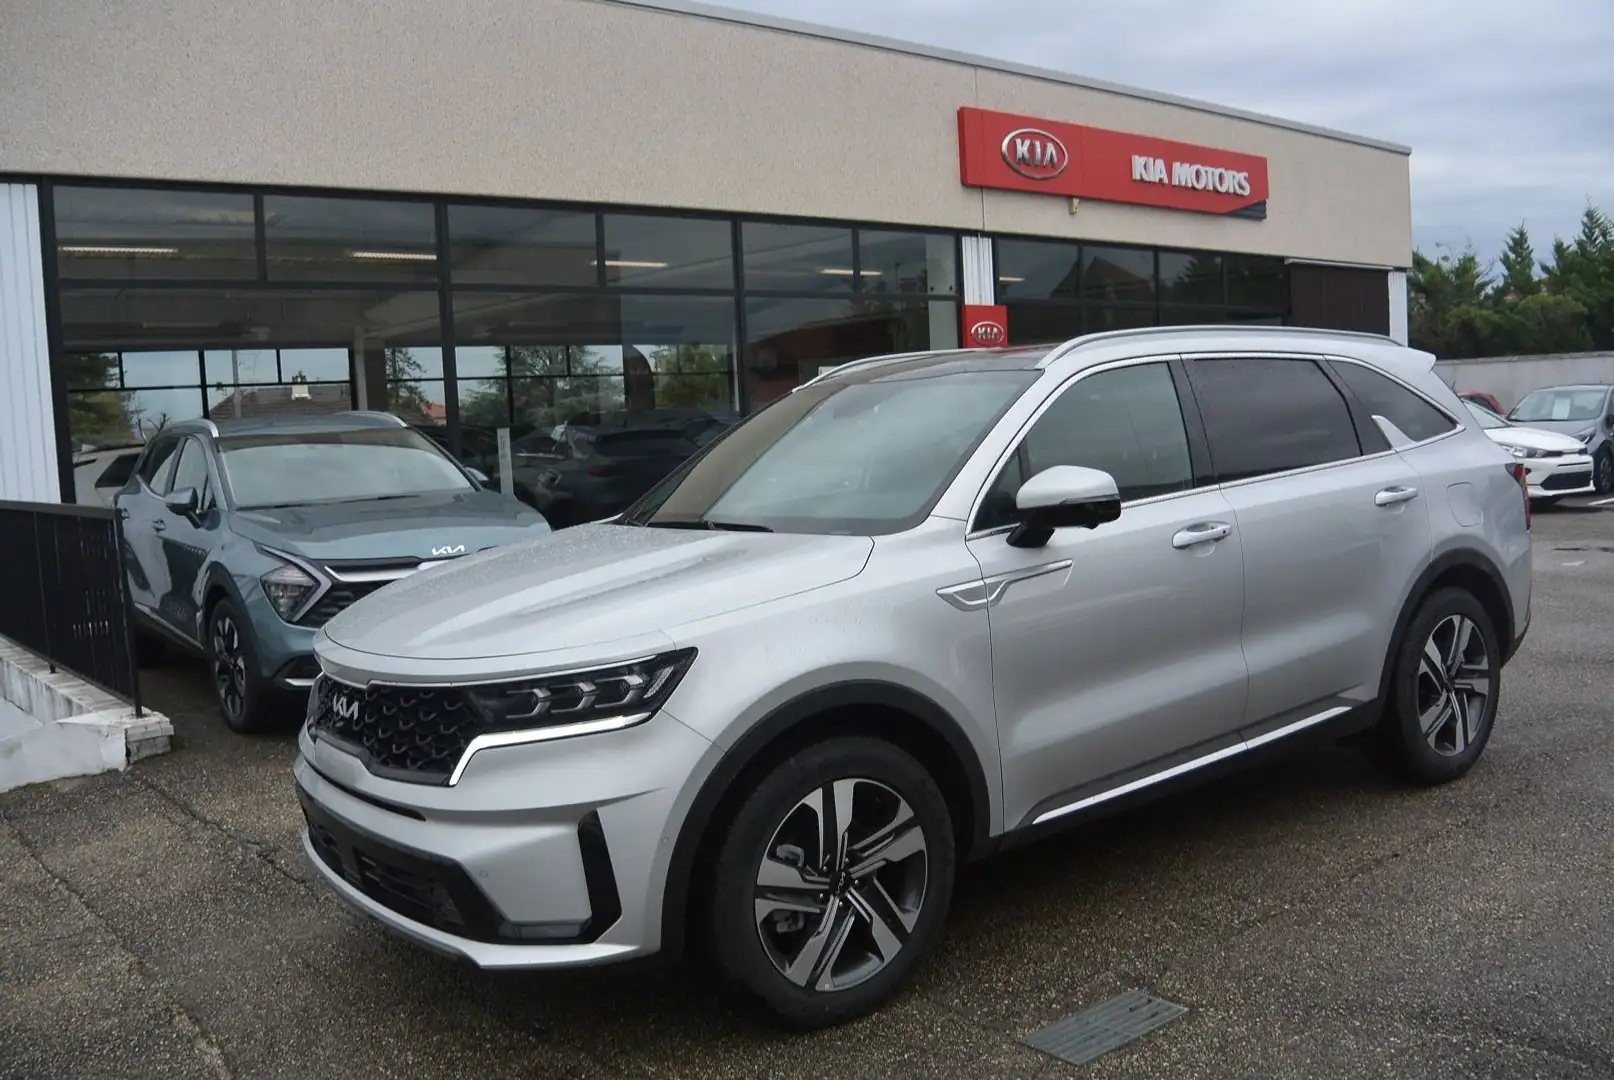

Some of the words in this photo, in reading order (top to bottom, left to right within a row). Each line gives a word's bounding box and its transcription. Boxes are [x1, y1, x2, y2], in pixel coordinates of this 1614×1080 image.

[1015, 138, 1058, 168] KIA
[1131, 154, 1168, 184] KIA
[1172, 161, 1250, 196] MOTORS
[977, 326, 1000, 340] KIA
